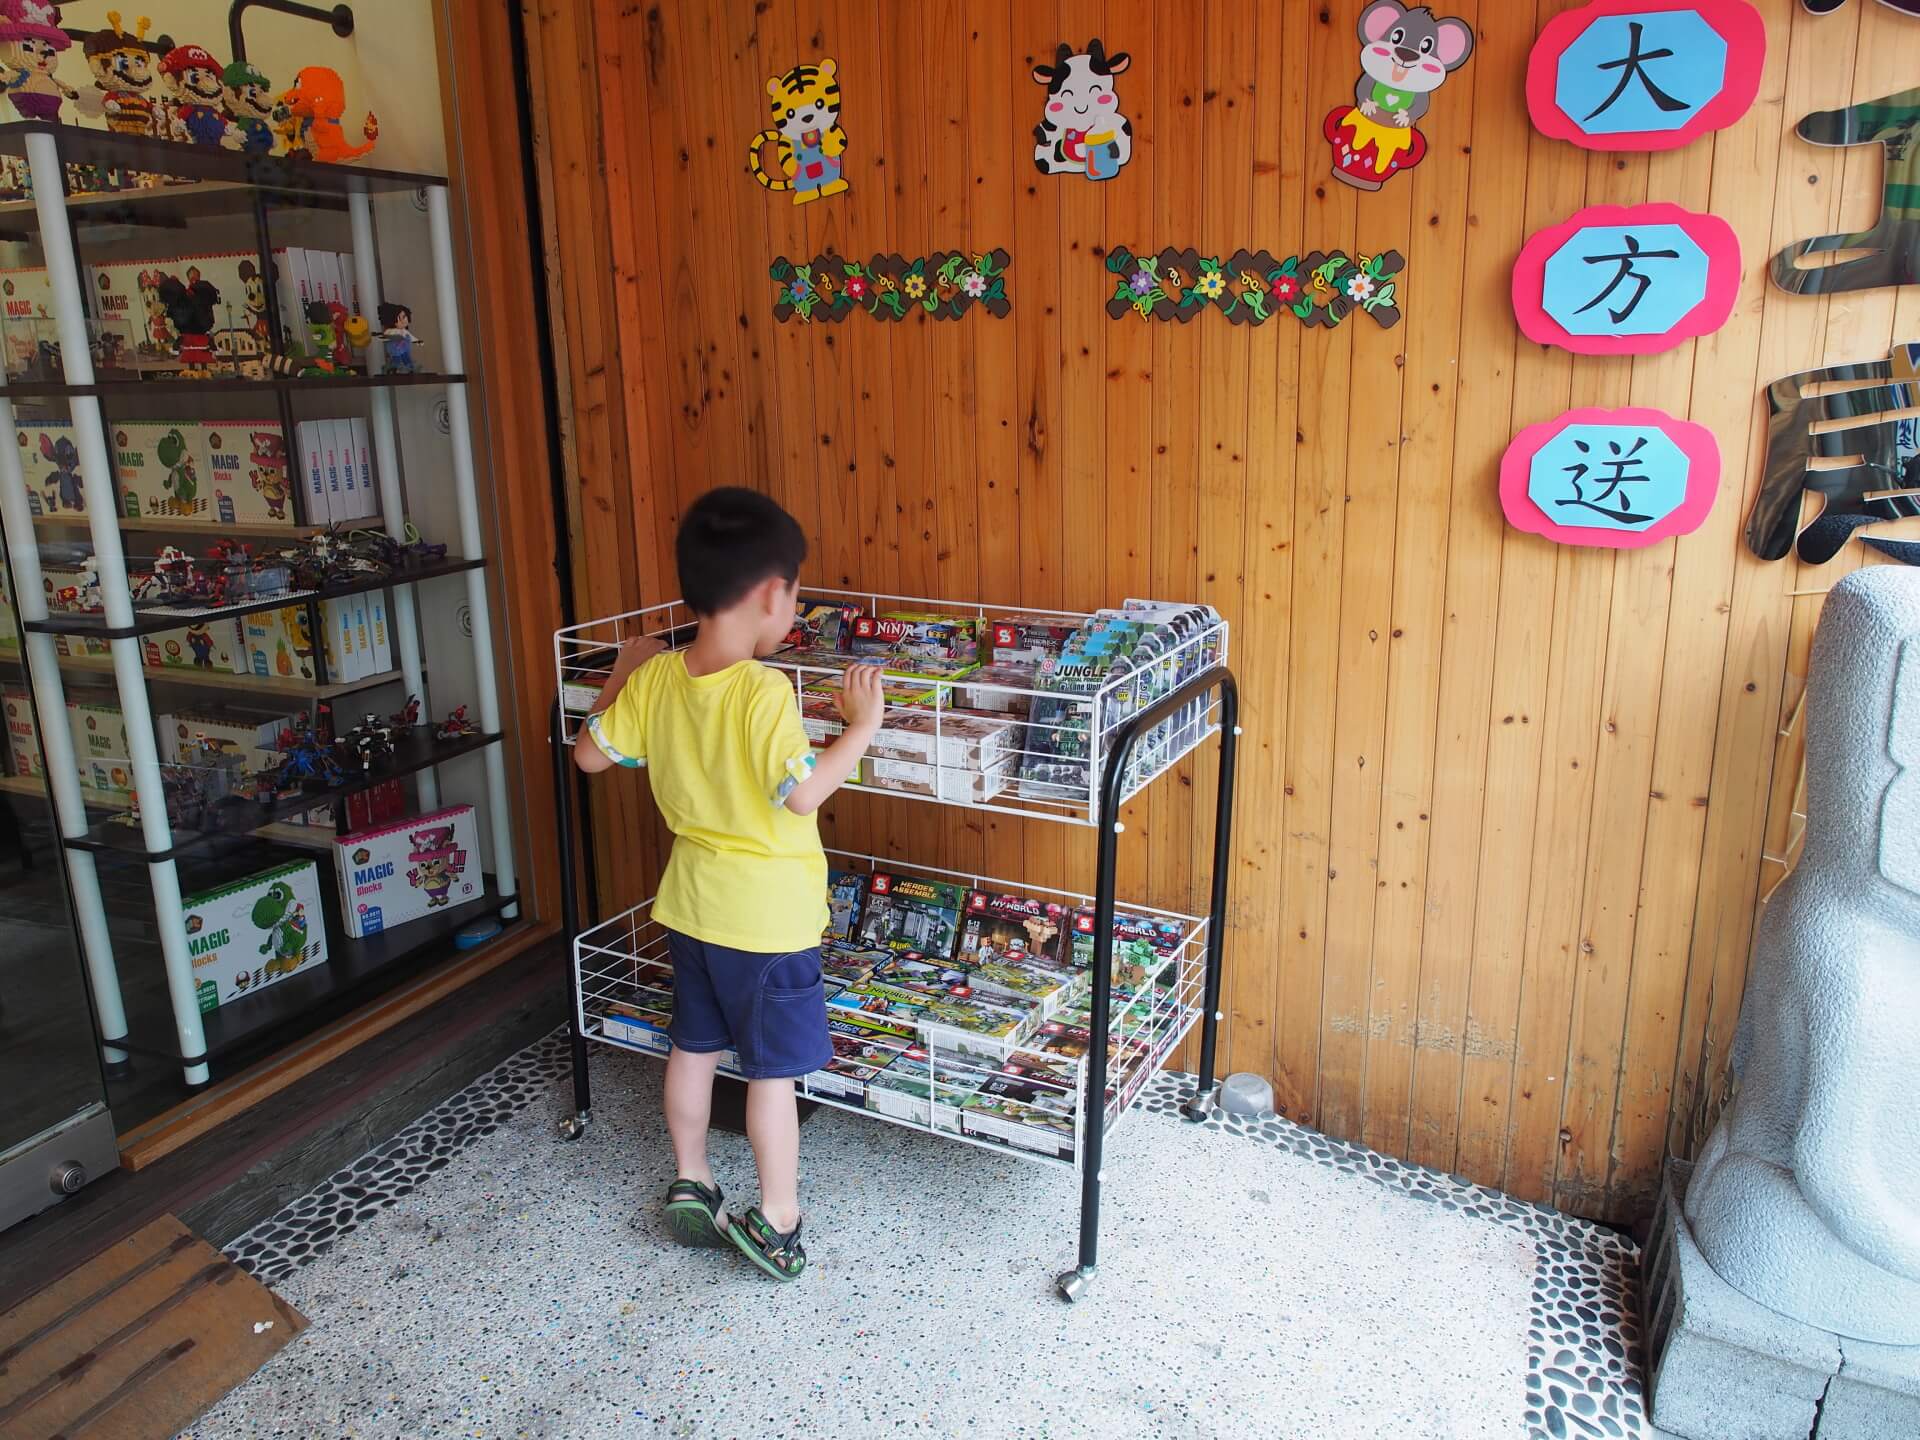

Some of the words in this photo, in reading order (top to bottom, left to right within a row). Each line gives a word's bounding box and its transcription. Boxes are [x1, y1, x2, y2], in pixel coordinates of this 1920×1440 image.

[1582, 22, 1692, 122] 大
[1572, 235, 1680, 324] 方
[6, 300, 32, 316] MAGIC
[101, 295, 129, 311] MAGIC
[118, 452, 144, 467] MAGIC
[211, 454, 240, 470] MAGIC
[1554, 437, 1655, 524] 送
[1054, 665, 1108, 678] JUNGLE
[9, 721, 32, 736] MAGIC
[353, 862, 395, 886] MAGIC
[356, 882, 383, 897] Blocks
[892, 886, 937, 899] ASSEMBLE
[900, 881, 935, 893] HEROES
[990, 900, 1005, 909] MY
[1006, 903, 1040, 915] WORLD
[1119, 924, 1157, 937] WORLD
[188, 928, 230, 957] MAGIC
